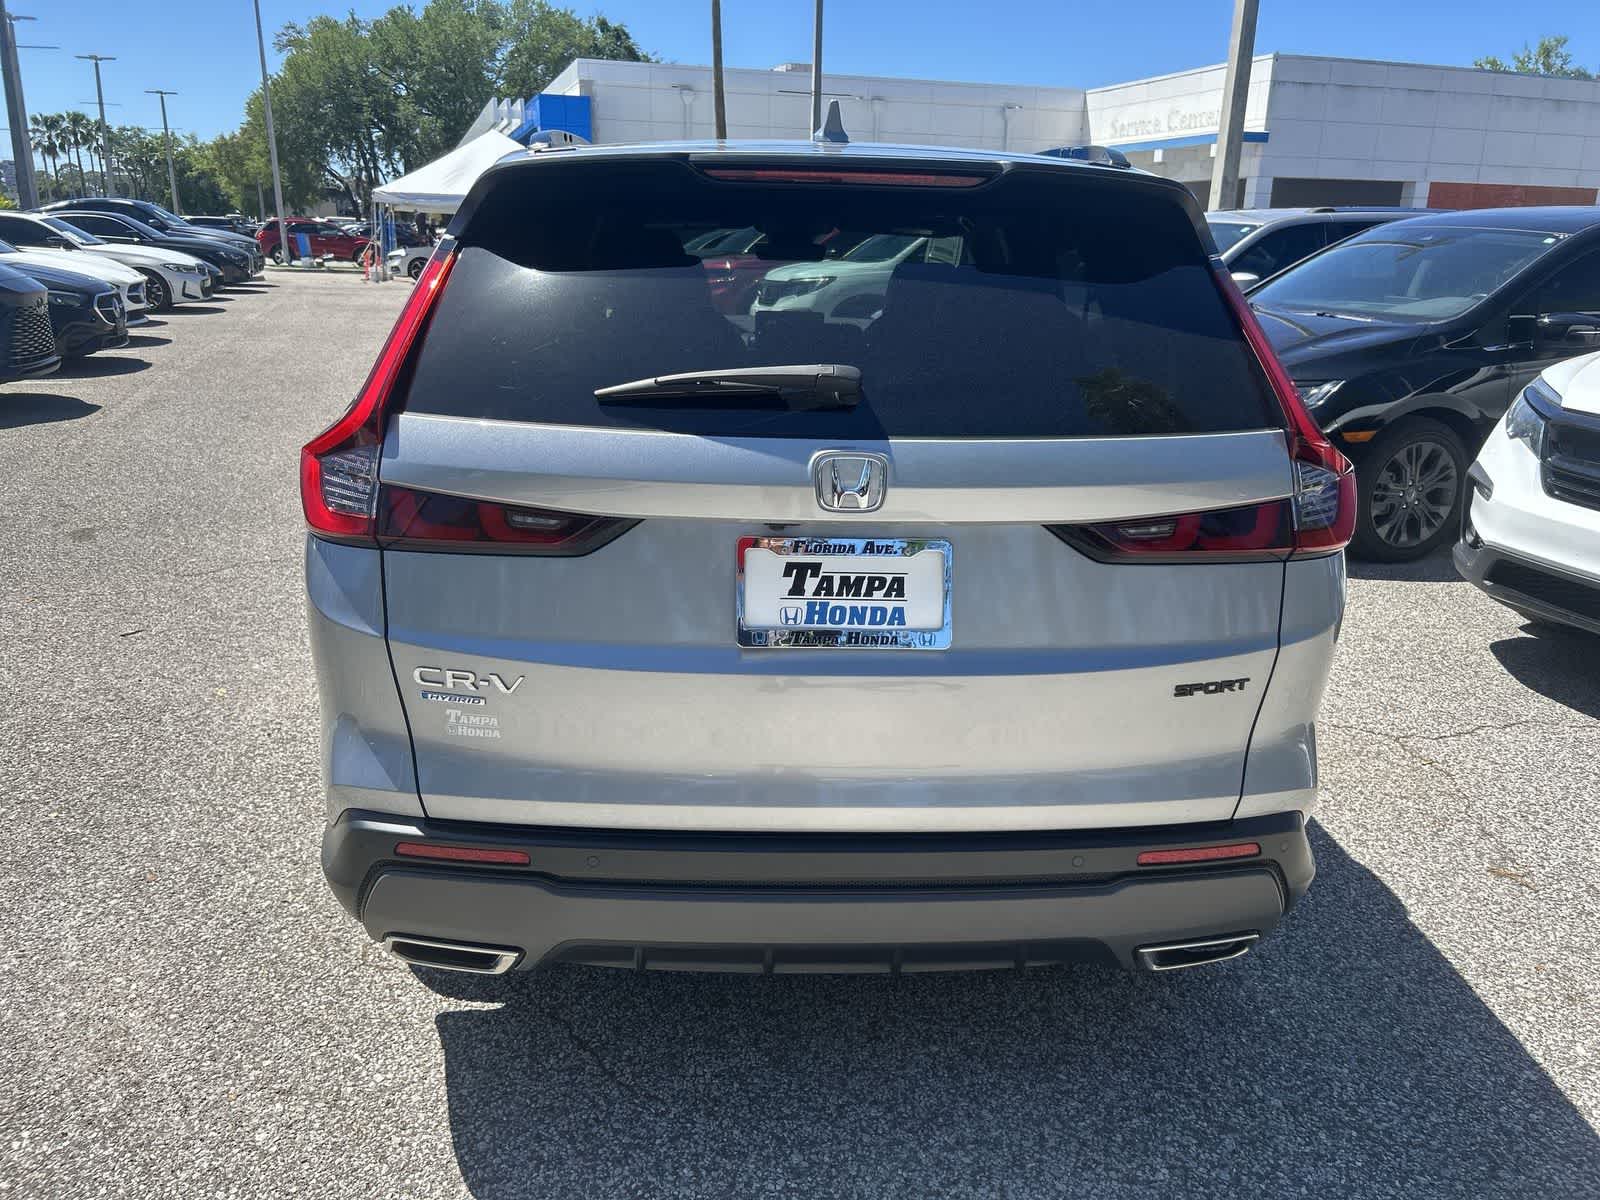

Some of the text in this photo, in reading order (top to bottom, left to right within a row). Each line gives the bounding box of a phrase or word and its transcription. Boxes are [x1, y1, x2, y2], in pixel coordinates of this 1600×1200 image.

[782, 561, 906, 598] TAMPA
[804, 601, 907, 626] HONDA
[412, 665, 526, 694] CR-V
[1173, 677, 1251, 697] SPORT
[427, 692, 483, 705] HYBRID
[446, 708, 499, 727] TAMPA
[456, 725, 502, 739] HONDA
